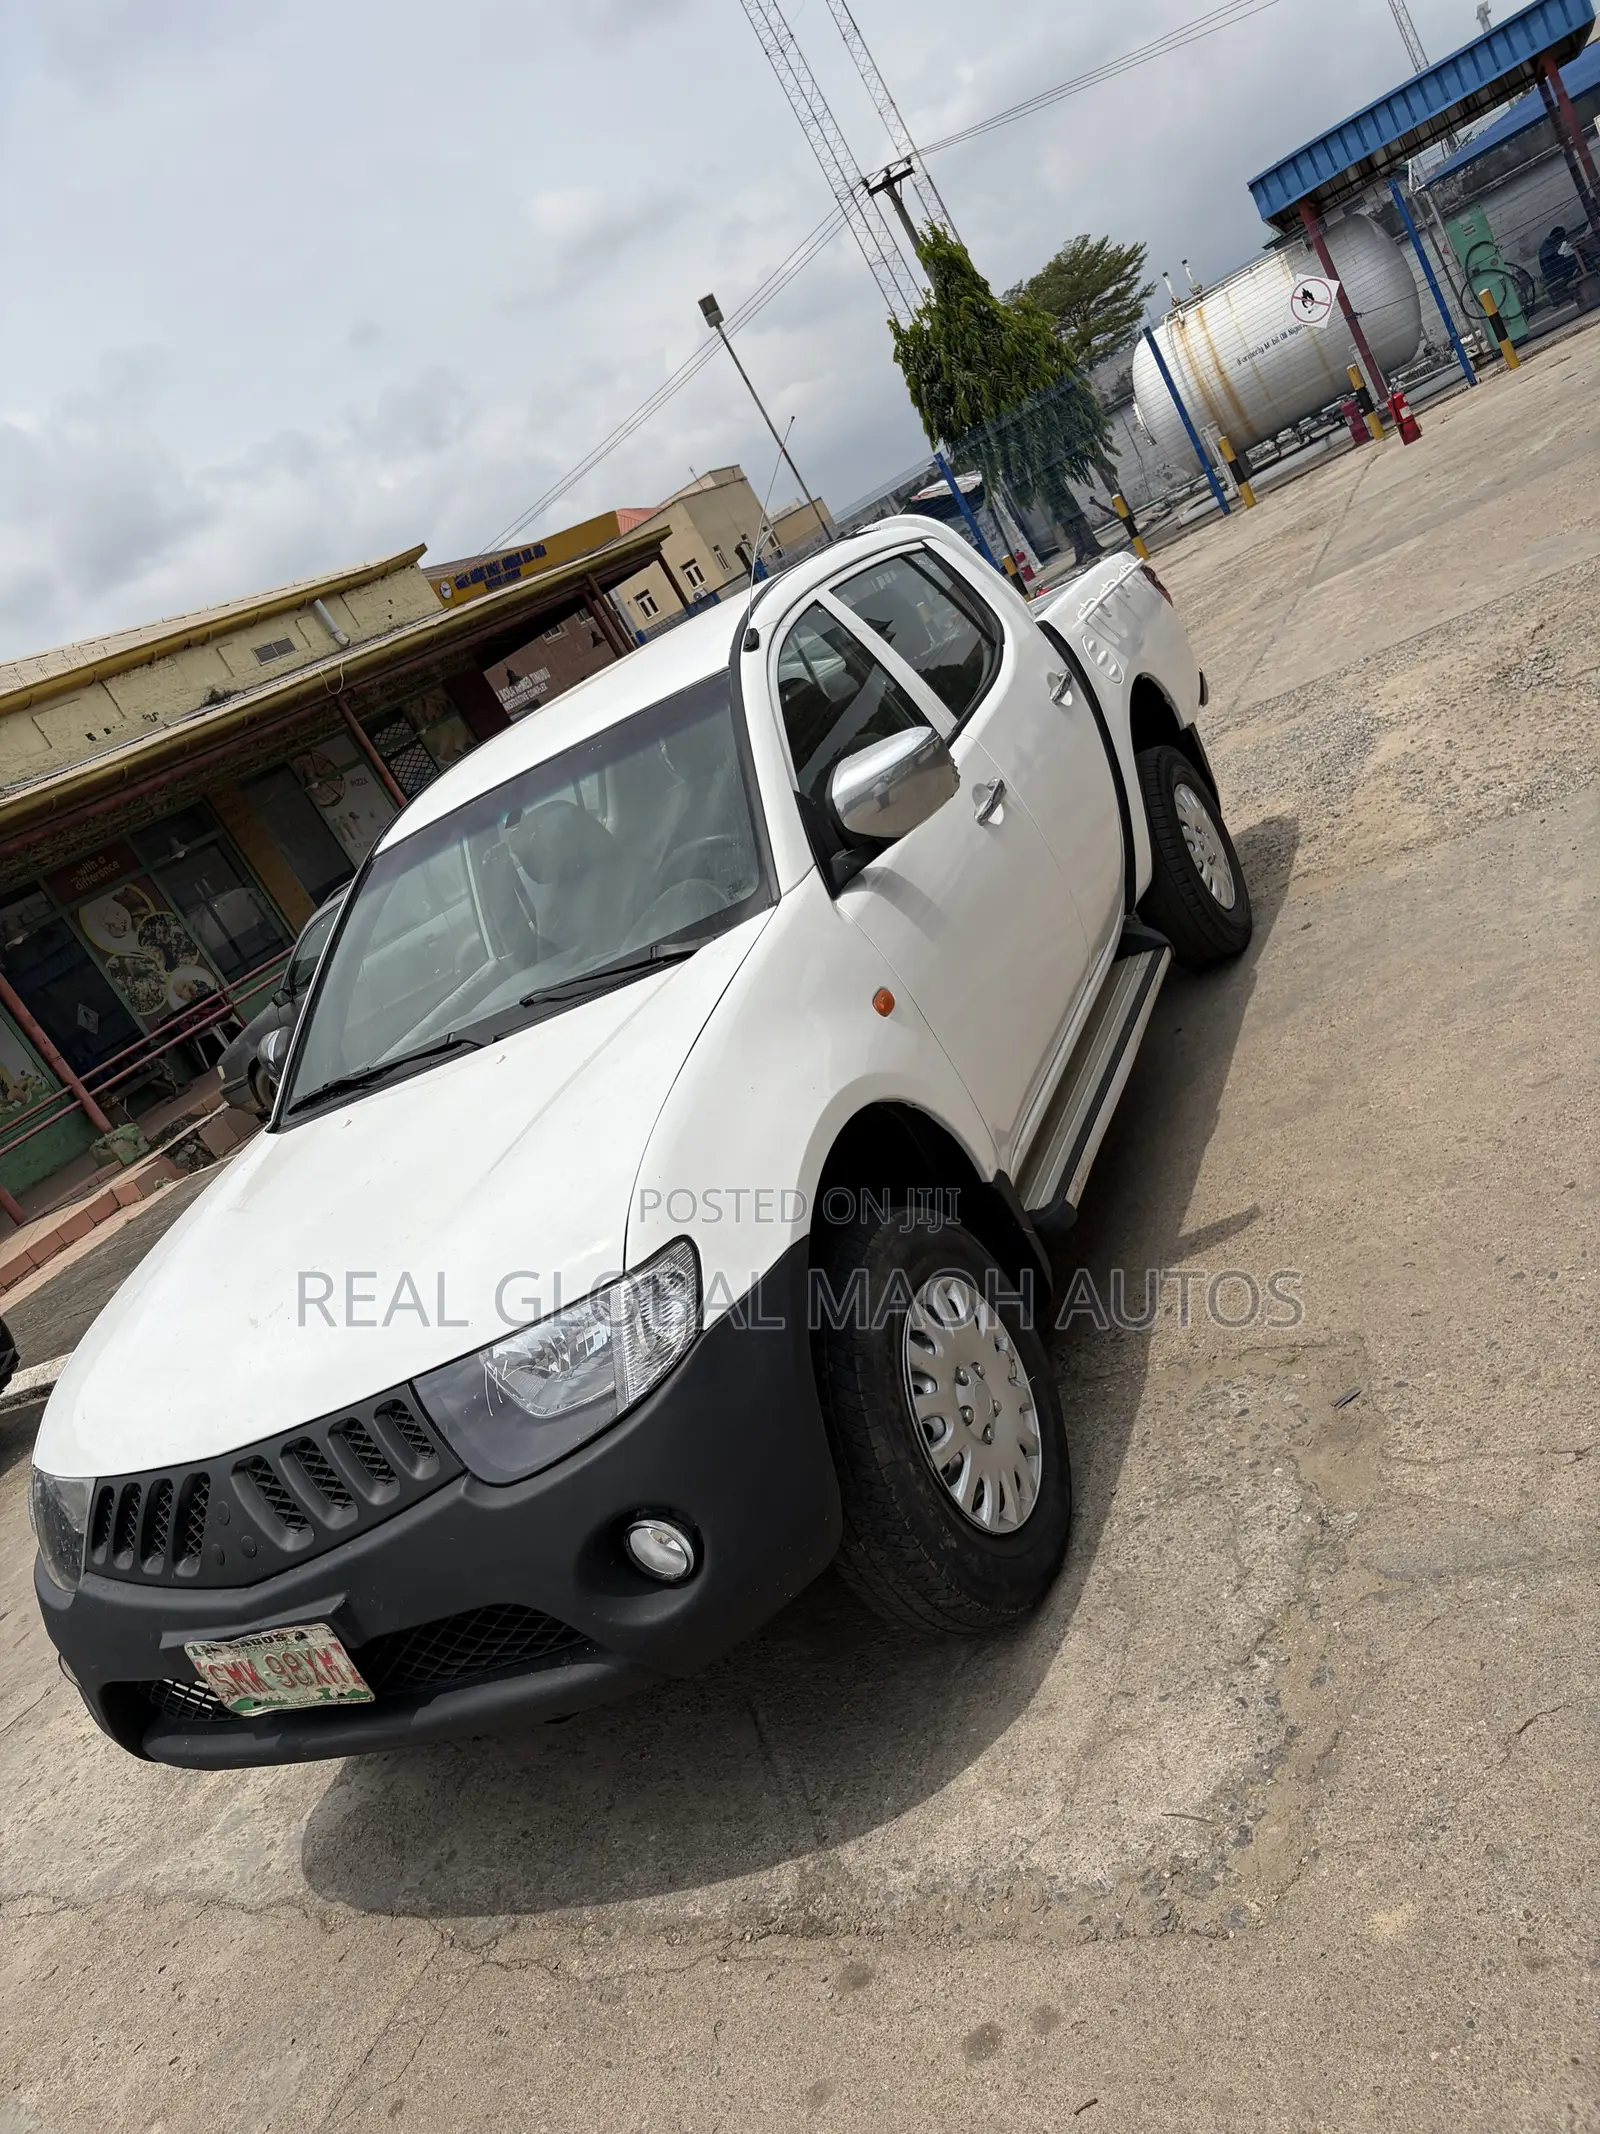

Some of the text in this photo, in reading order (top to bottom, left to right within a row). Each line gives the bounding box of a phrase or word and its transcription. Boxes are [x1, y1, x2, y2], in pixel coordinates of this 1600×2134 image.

[349, 777, 369, 788] PIZZA
[75, 861, 120, 891] difference
[226, 1633, 288, 1649] LAGOS
